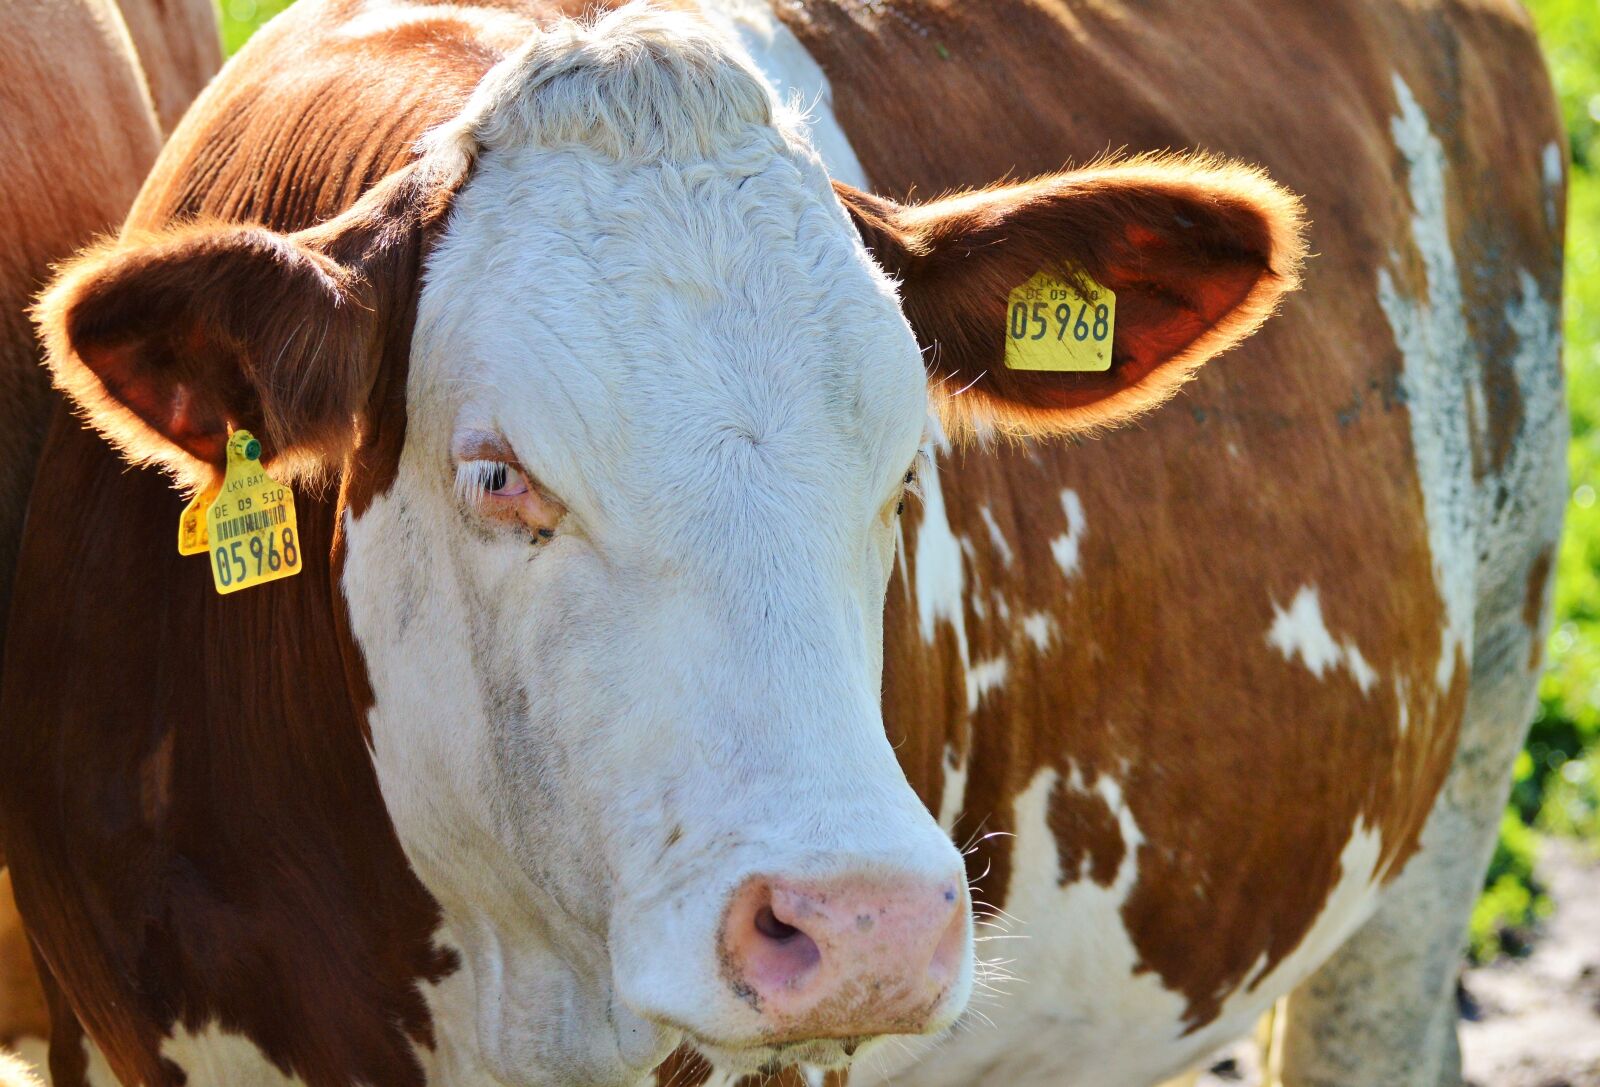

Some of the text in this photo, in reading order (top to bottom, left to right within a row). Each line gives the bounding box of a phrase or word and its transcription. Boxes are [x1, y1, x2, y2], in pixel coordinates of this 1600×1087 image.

[1050, 290, 1067, 300] 09
[1074, 290, 1098, 301] 50
[1010, 301, 1109, 342] 05968
[226, 473, 264, 493] LKV BAY
[214, 488, 284, 519] DE 09 510
[215, 527, 298, 587] 05968
